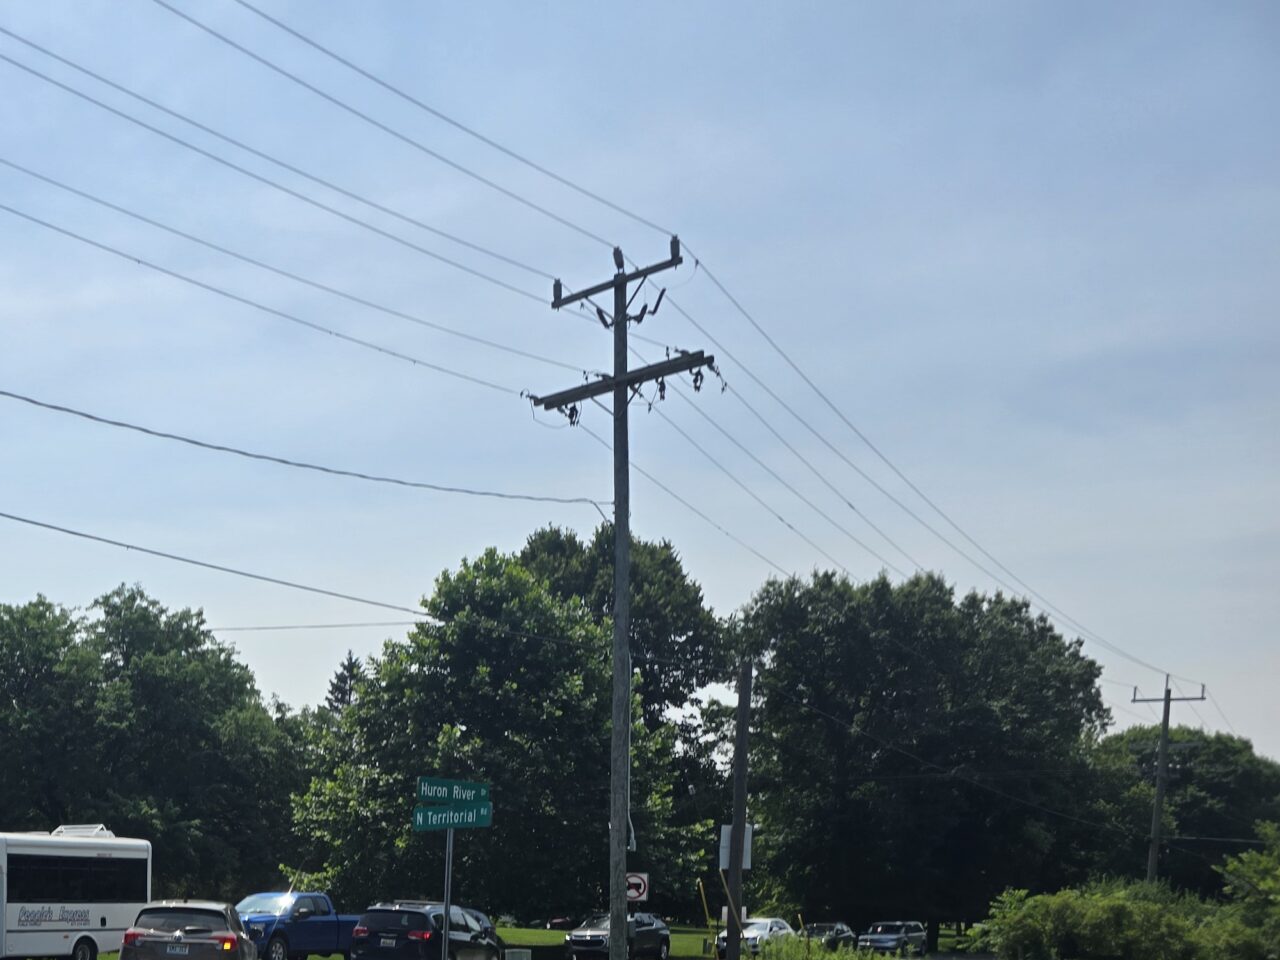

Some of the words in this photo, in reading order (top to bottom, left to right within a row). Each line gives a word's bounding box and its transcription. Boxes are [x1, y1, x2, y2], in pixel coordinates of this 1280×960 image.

[421, 782, 448, 798] Huron
[452, 784, 476, 800] River
[416, 812, 423, 826] N
[427, 808, 477, 825] Territorial
[480, 807, 488, 816] Rd
